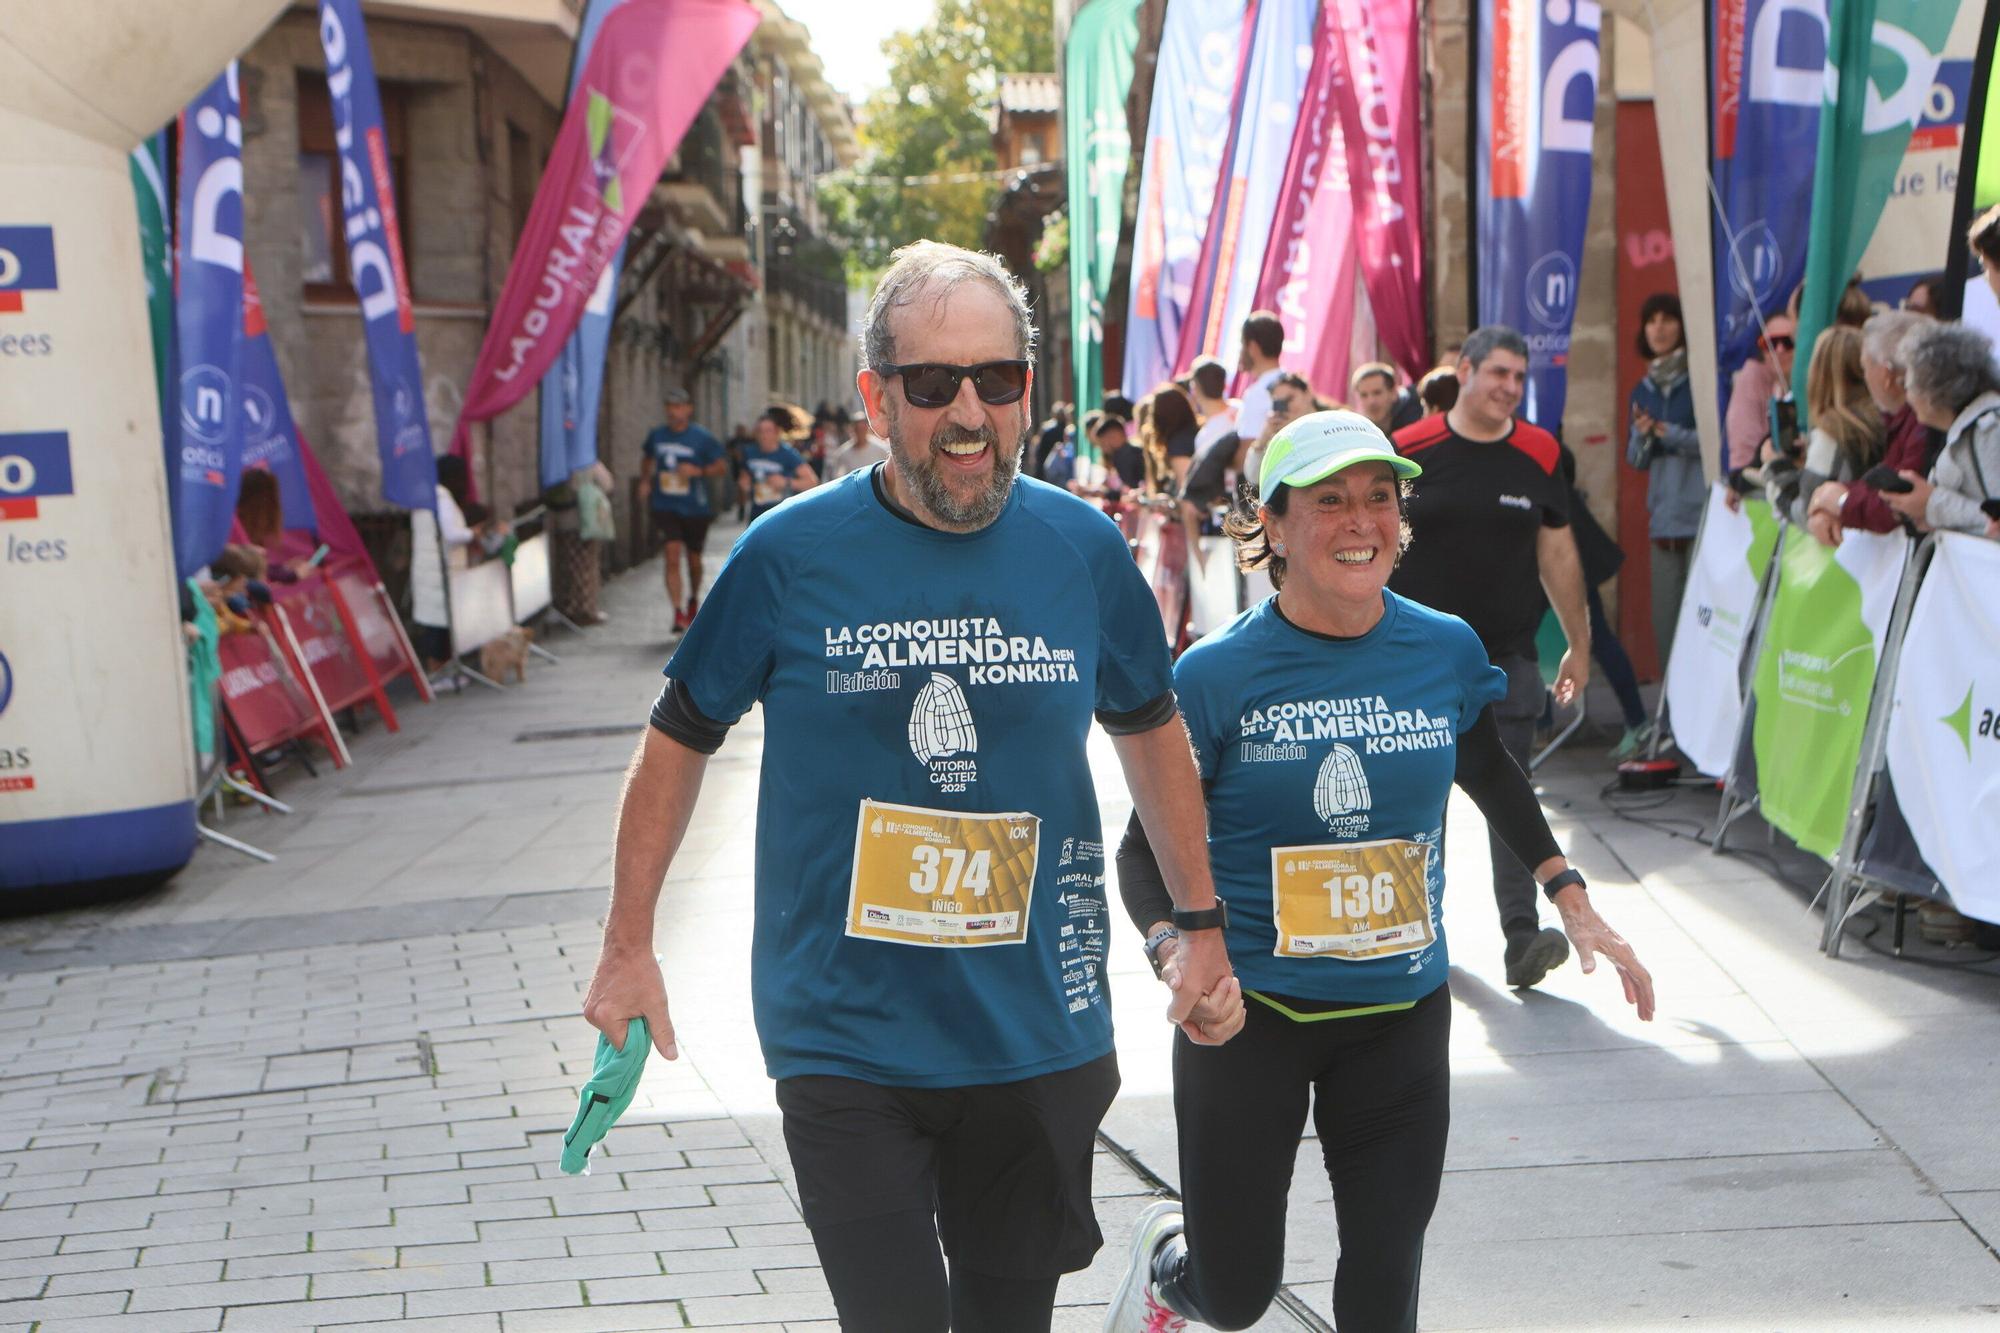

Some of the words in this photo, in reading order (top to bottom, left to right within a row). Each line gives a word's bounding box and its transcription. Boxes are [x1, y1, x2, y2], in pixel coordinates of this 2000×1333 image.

[7, 532, 67, 563] lees
[825, 626, 852, 645] LA
[856, 617, 1003, 644] CONQUISTA
[825, 645, 843, 657] DE
[847, 644, 864, 656] LA
[862, 636, 1052, 669] ALMENDRA
[1053, 648, 1075, 662] REN
[840, 669, 900, 693] Edición
[968, 664, 1079, 685] KONKISTA
[1240, 710, 1265, 727] LA
[1266, 695, 1390, 721] CONQUISTA
[1241, 726, 1257, 737] DE
[1258, 721, 1276, 733] LA
[1273, 708, 1433, 743] ALMENDRA
[1431, 716, 1449, 729] REN
[1252, 743, 1307, 762] Edición
[1365, 730, 1453, 755] KONKISTA
[929, 759, 977, 772] VITORIA
[929, 771, 977, 784] GASTEIZ
[941, 783, 966, 793] 2025
[1329, 815, 1370, 826] VITORIA
[909, 844, 992, 897] 374
[1056, 873, 1093, 886] LABORAL
[932, 899, 963, 913] IÑIGO
[1322, 871, 1395, 919] 136
[1353, 921, 1370, 933] ANA
